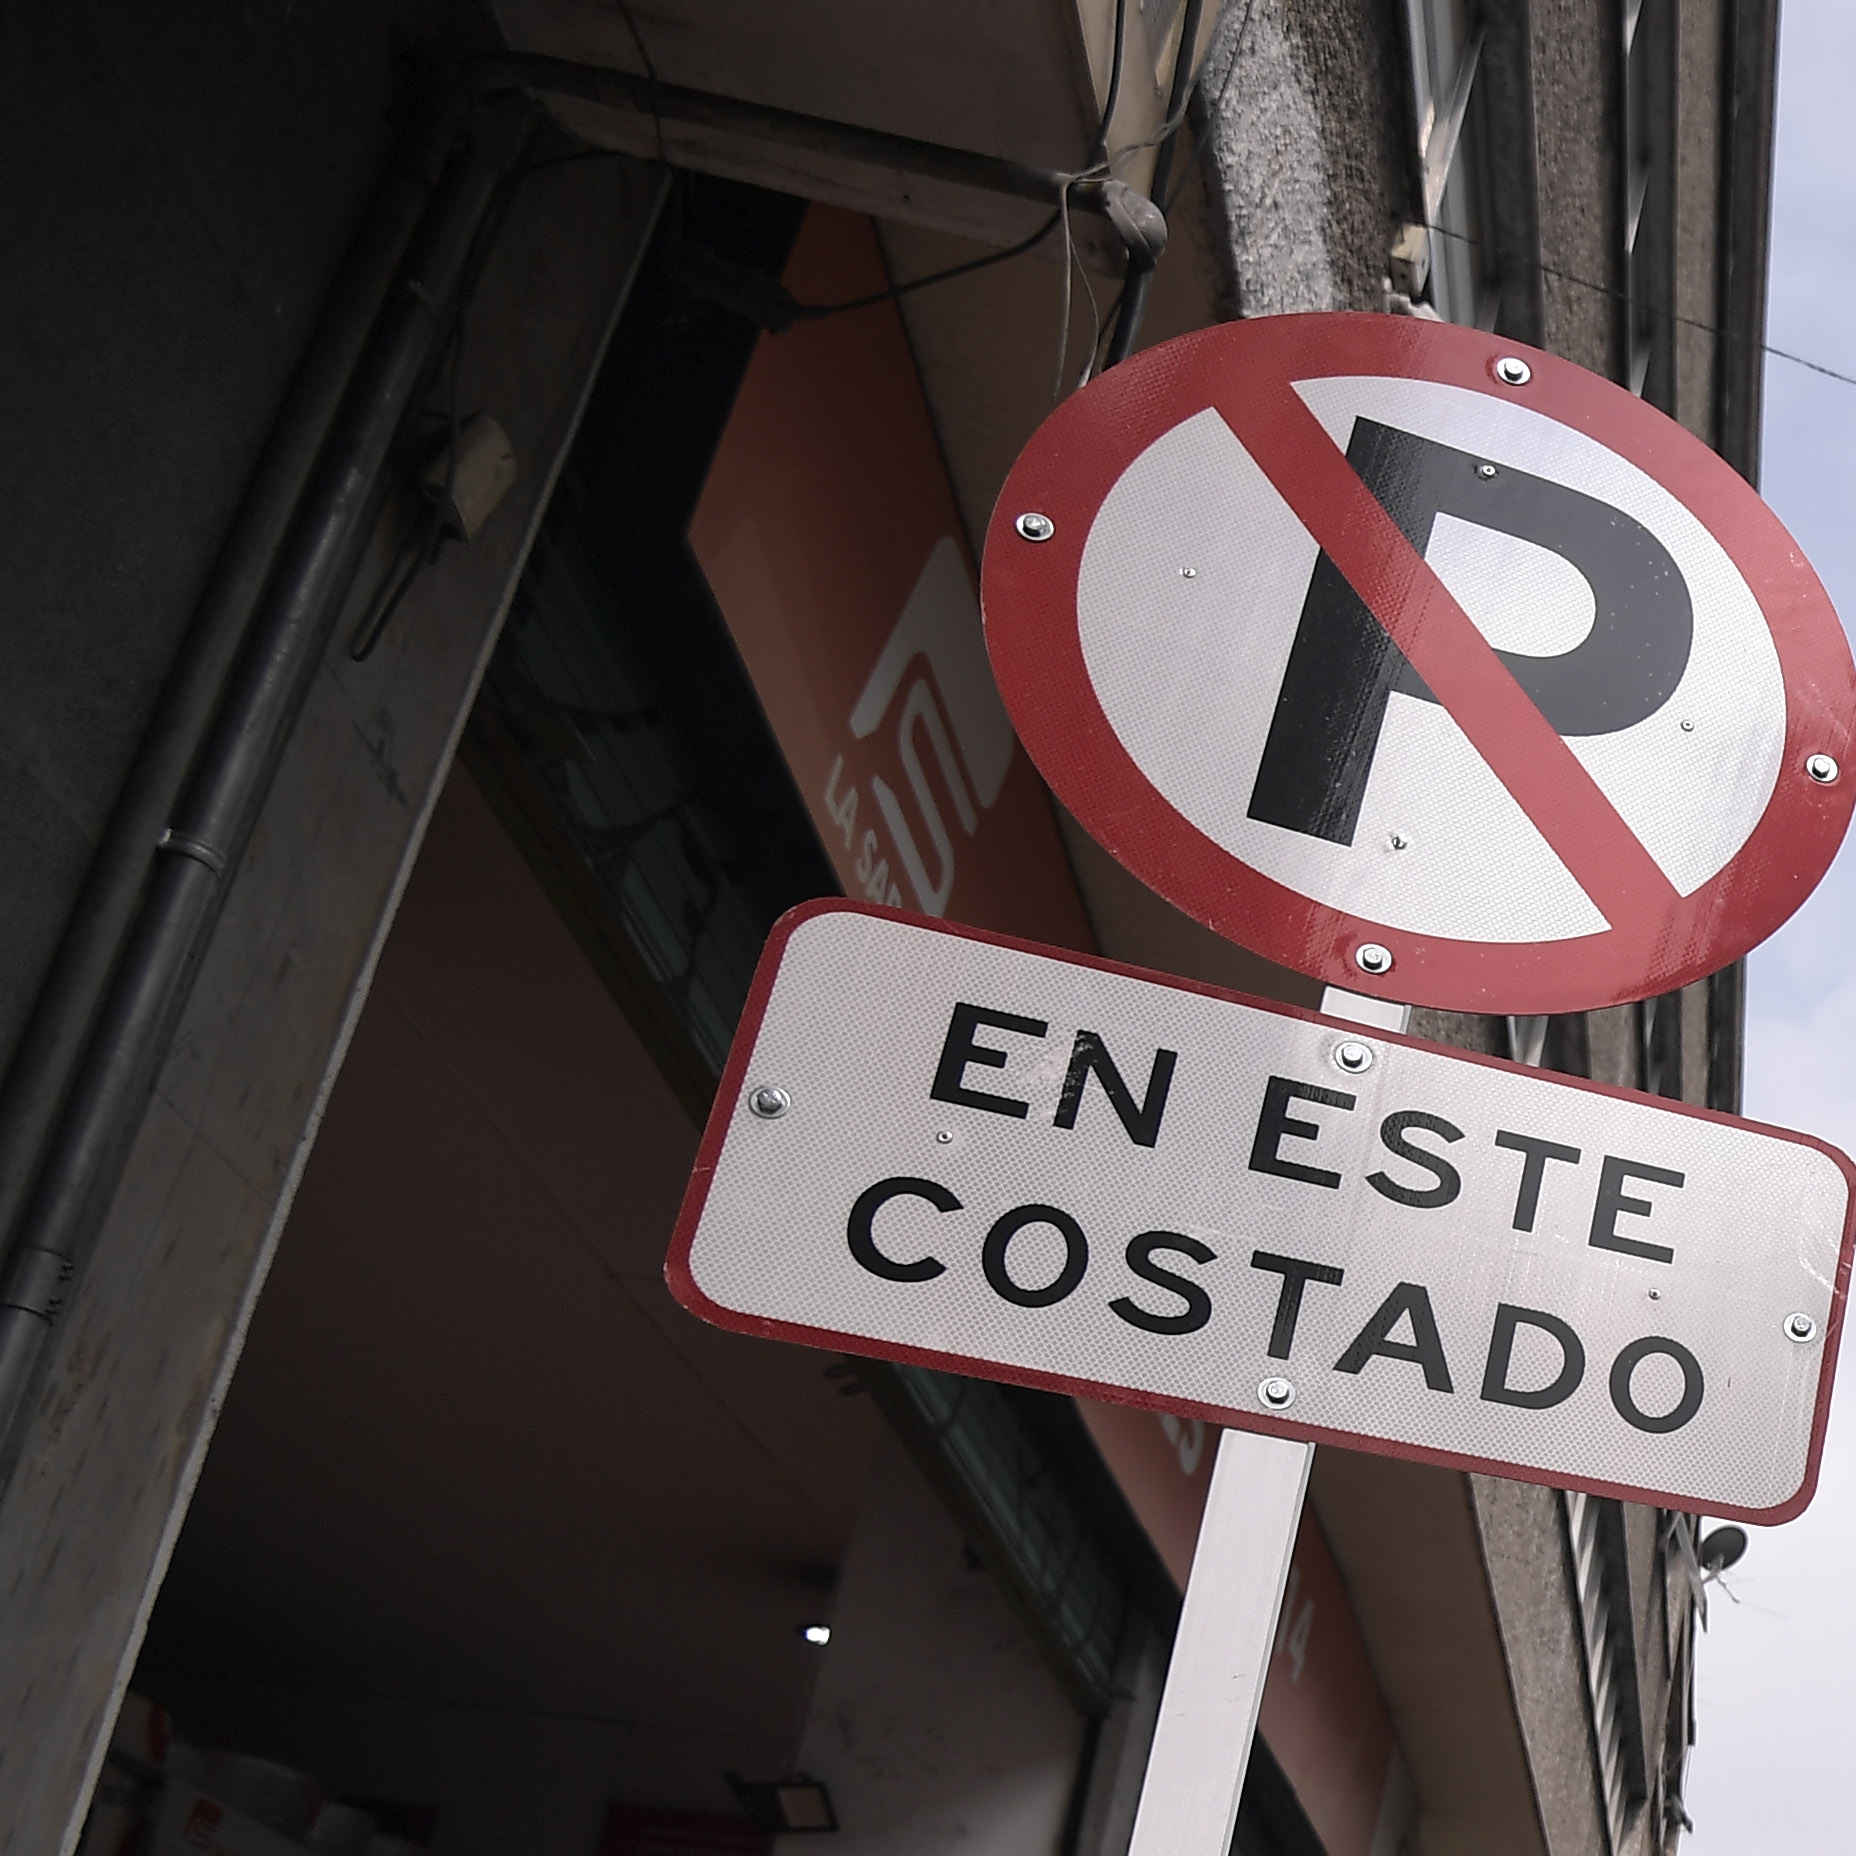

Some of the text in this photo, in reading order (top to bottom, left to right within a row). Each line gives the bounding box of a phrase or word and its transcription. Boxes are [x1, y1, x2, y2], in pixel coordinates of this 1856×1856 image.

[1245, 415, 1694, 848] P
[928, 1000, 1687, 1264] EN ESTE
[845, 1176, 1705, 1434] COSTADO
